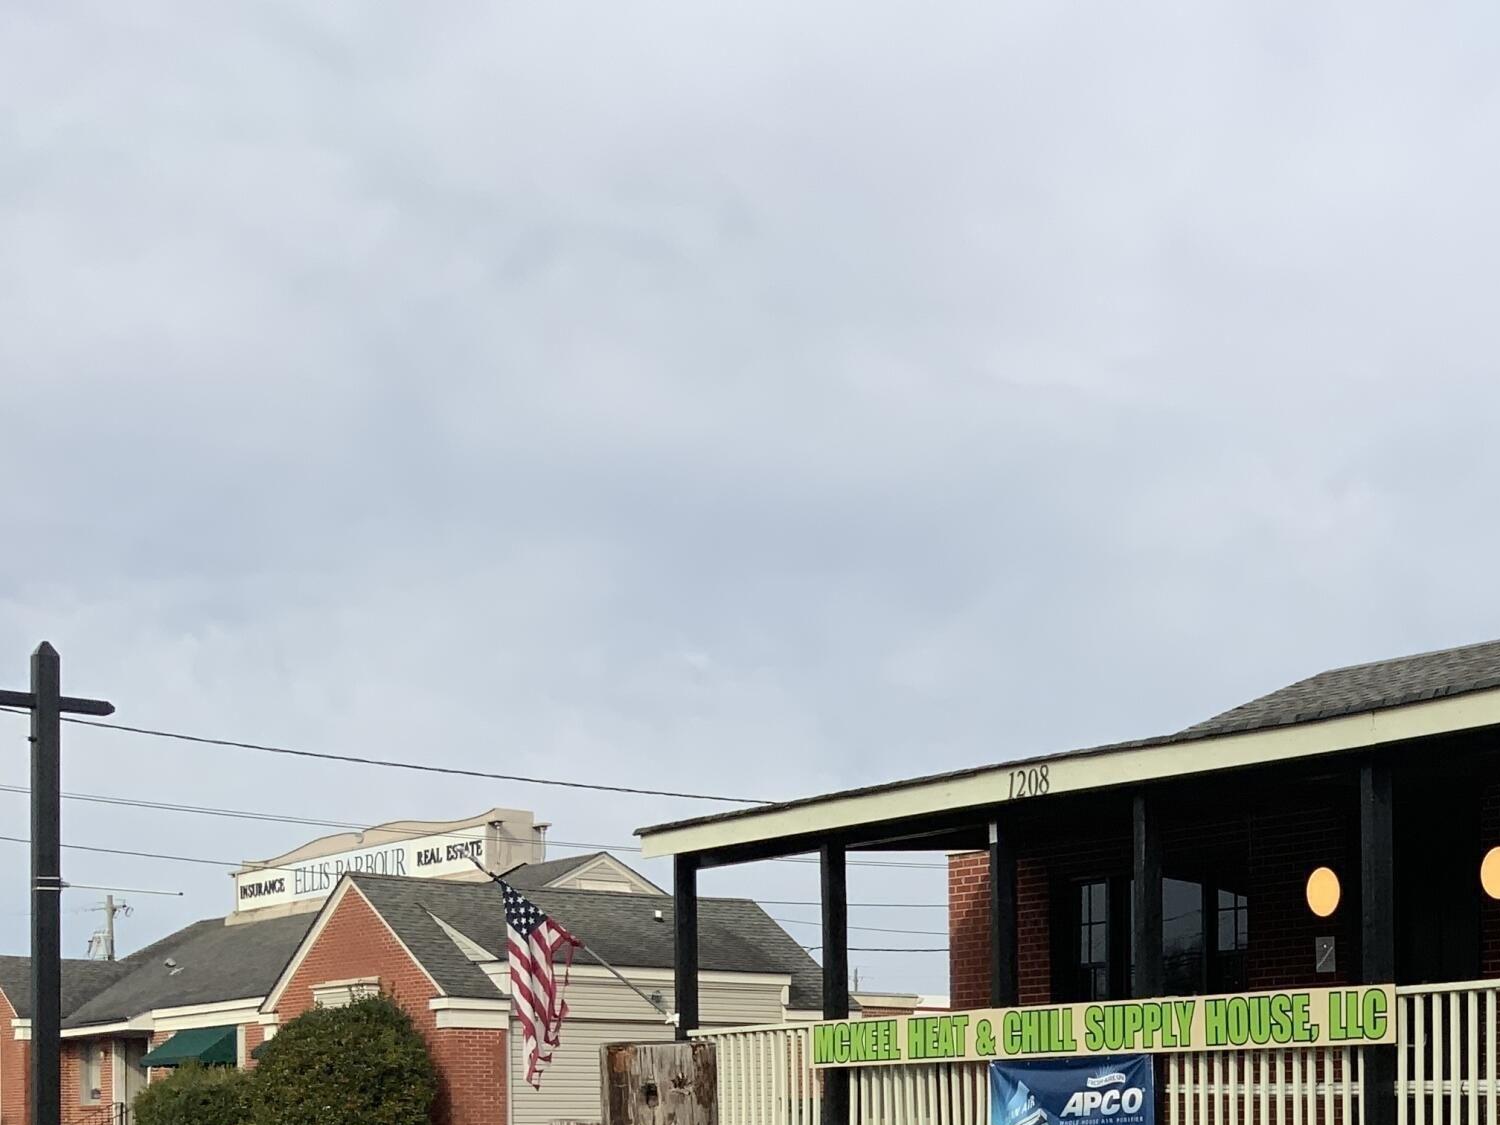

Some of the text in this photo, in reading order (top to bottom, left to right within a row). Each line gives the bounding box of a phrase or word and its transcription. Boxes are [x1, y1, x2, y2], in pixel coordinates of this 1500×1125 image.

[1009, 764, 1049, 799] 1208
[417, 840, 483, 867] REAL ESTATE
[240, 878, 285, 900] INSURANCE
[294, 862, 331, 896] ELLIS
[814, 988, 1388, 1064] MCKEEL HEAT & CHILL SUPPLY HOUSE, LLC
[1060, 1087, 1144, 1118] APCO
